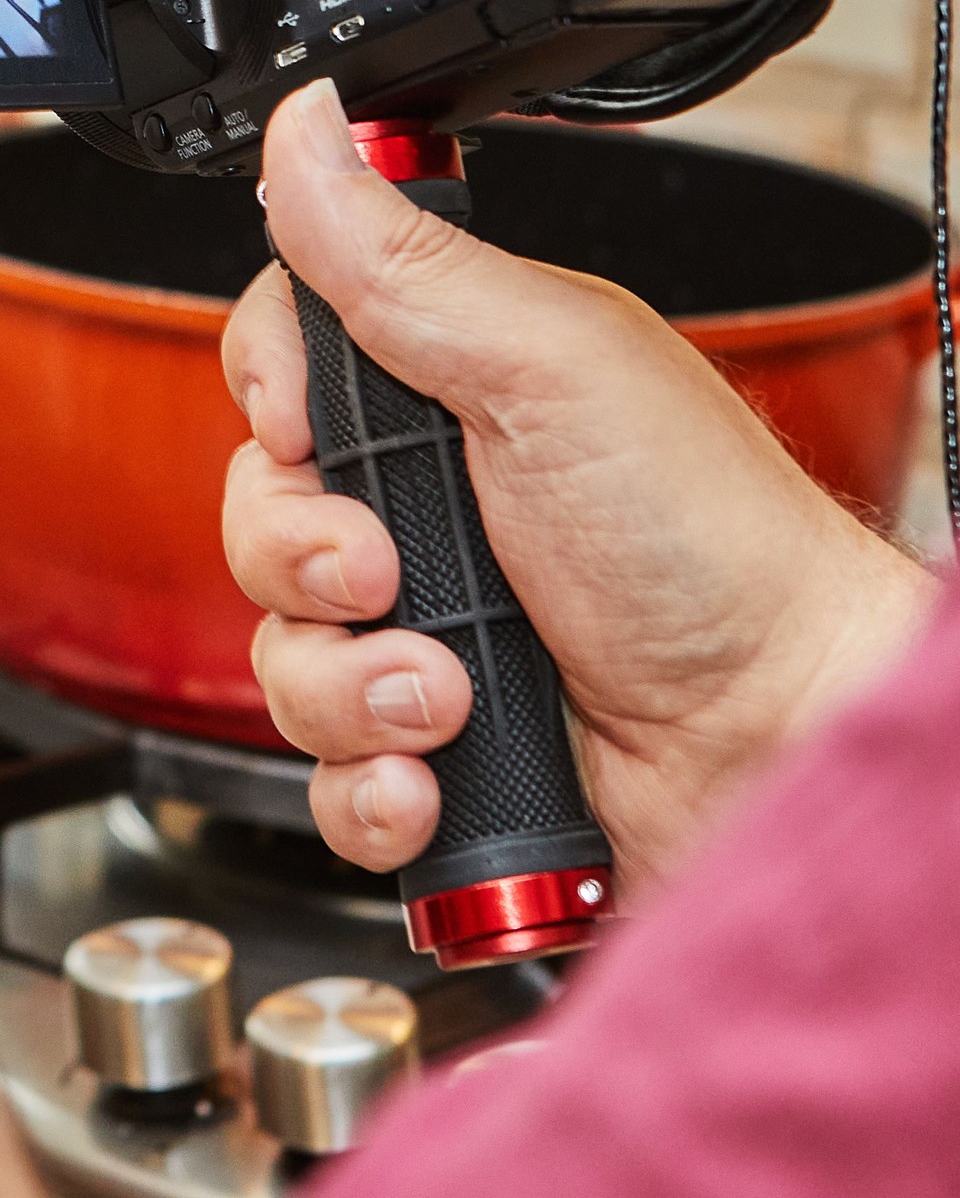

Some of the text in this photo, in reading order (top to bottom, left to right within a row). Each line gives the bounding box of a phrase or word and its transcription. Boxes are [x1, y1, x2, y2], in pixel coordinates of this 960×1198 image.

[175, 128, 206, 147] CAMERA
[226, 121, 258, 140] MANUAL
[177, 140, 212, 159] FUNCTION
